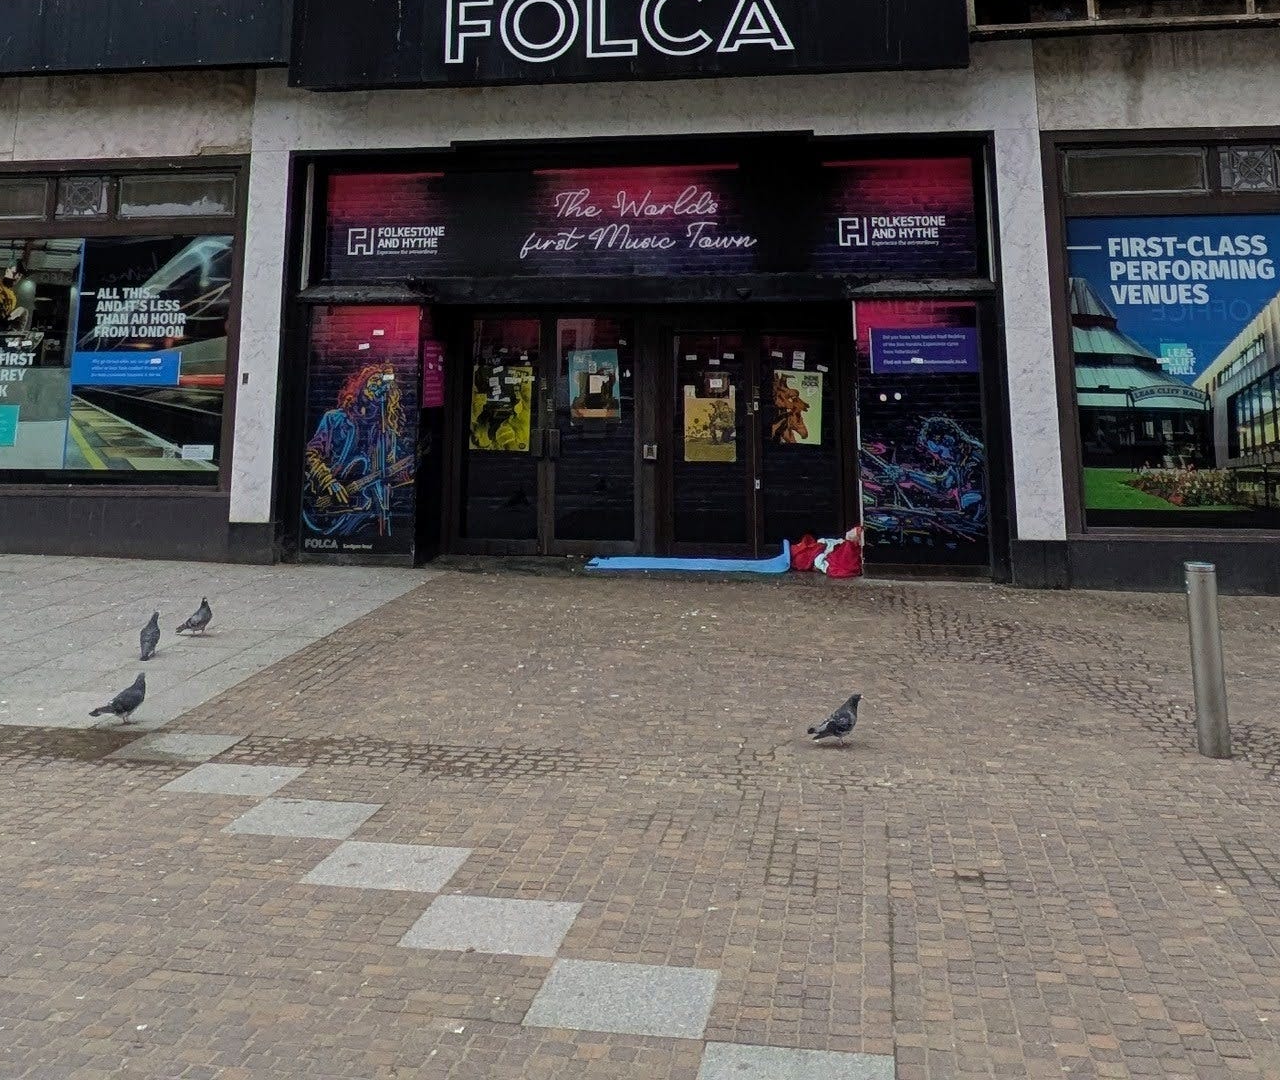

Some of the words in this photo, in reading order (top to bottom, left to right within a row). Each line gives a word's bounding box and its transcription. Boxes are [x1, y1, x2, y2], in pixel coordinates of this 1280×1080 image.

[553, 187, 603, 218] The
[871, 215, 946, 228] FOLKESTONE
[377, 226, 445, 238] FOLKESTONE
[871, 228, 896, 239] AND
[898, 227, 940, 239] HYTHE
[377, 238, 400, 249] AND
[401, 237, 438, 249] HYTHE
[519, 226, 586, 260] first
[588, 223, 677, 251] Music
[686, 221, 758, 249] Town
[1107, 235, 1269, 258] FIRST-CLASS
[1109, 258, 1276, 281] PERFORMING
[96, 287, 120, 299] ALL
[1110, 283, 1211, 305] VENUES
[95, 300, 121, 312] AND
[121, 300, 148, 312] IT'S
[150, 300, 180, 312] LESS
[95, 313, 128, 325] THAN
[129, 313, 149, 325] AN
[150, 313, 187, 325] HOUR
[94, 326, 129, 338] FROM
[131, 325, 185, 338] LONDON
[1168, 366, 1197, 375] HALL
[304, 538, 339, 549] FOLCA
